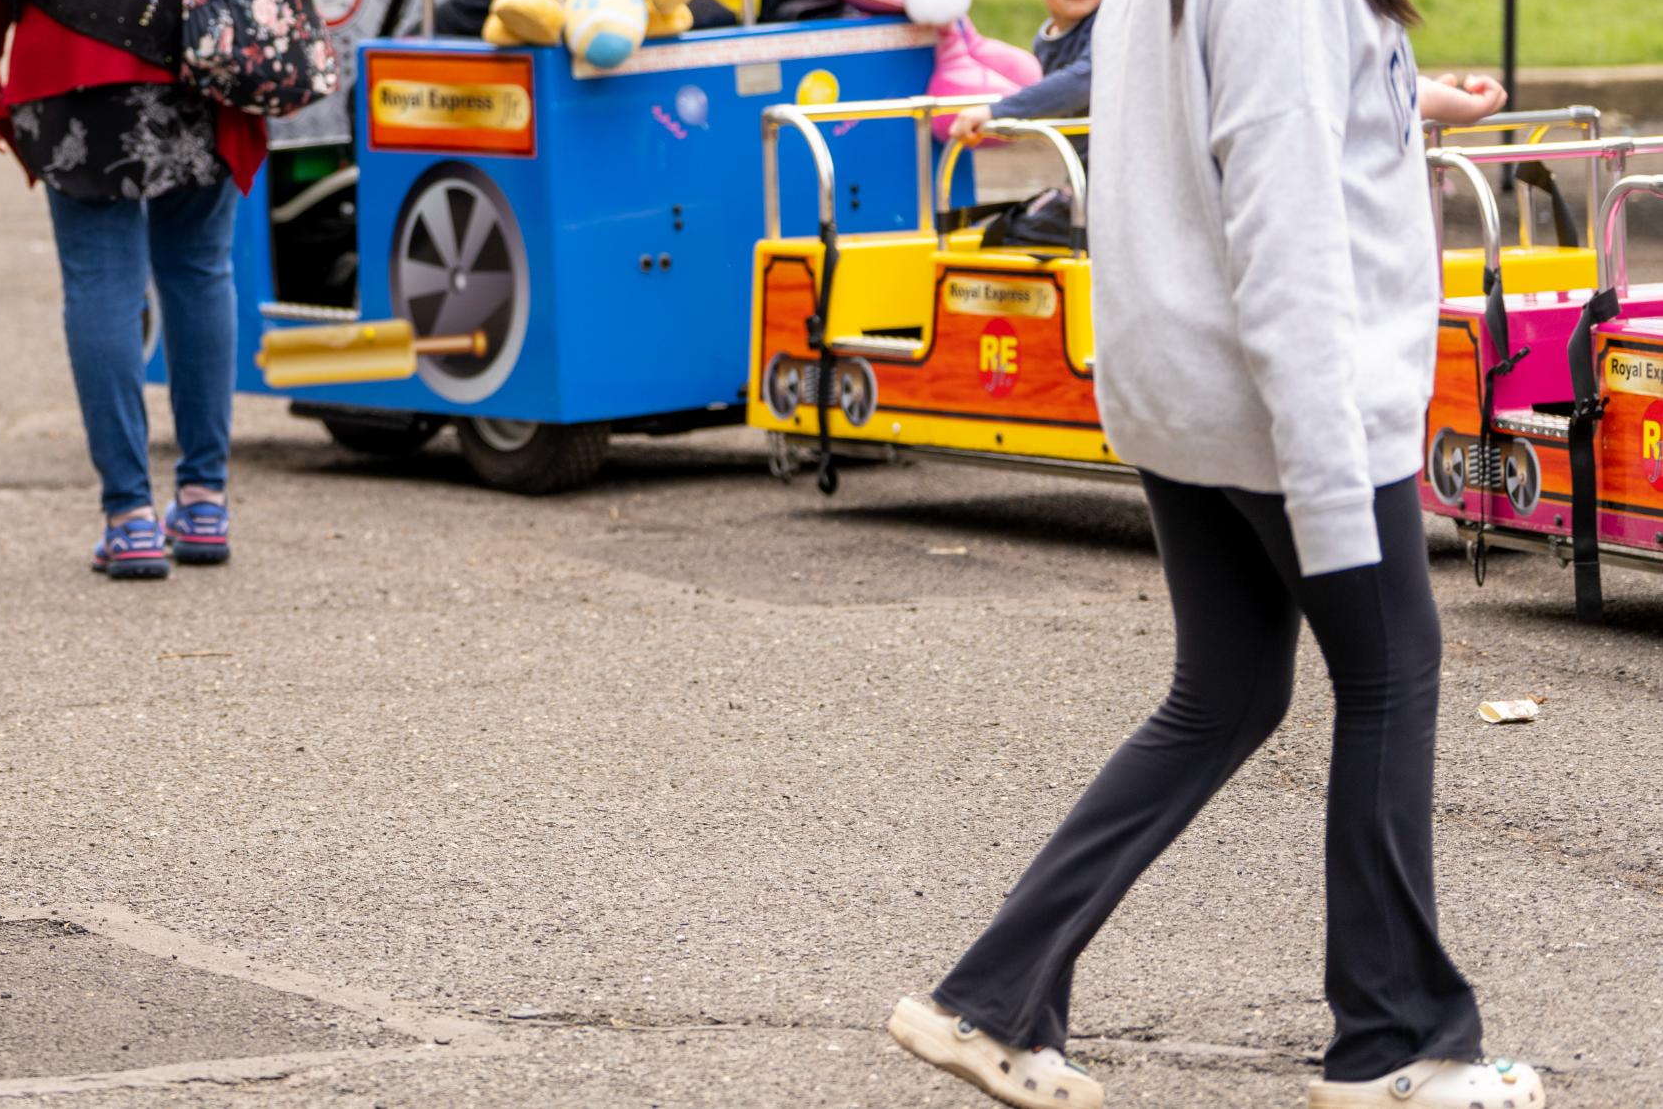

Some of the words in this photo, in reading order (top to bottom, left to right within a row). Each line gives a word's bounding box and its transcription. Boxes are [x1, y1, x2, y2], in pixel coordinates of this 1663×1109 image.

[381, 87, 422, 112] Royal
[429, 90, 494, 113] Express
[950, 282, 979, 302] Royal
[984, 285, 1031, 303] Express
[980, 335, 1018, 373] RE
[1610, 358, 1642, 381] Royal
